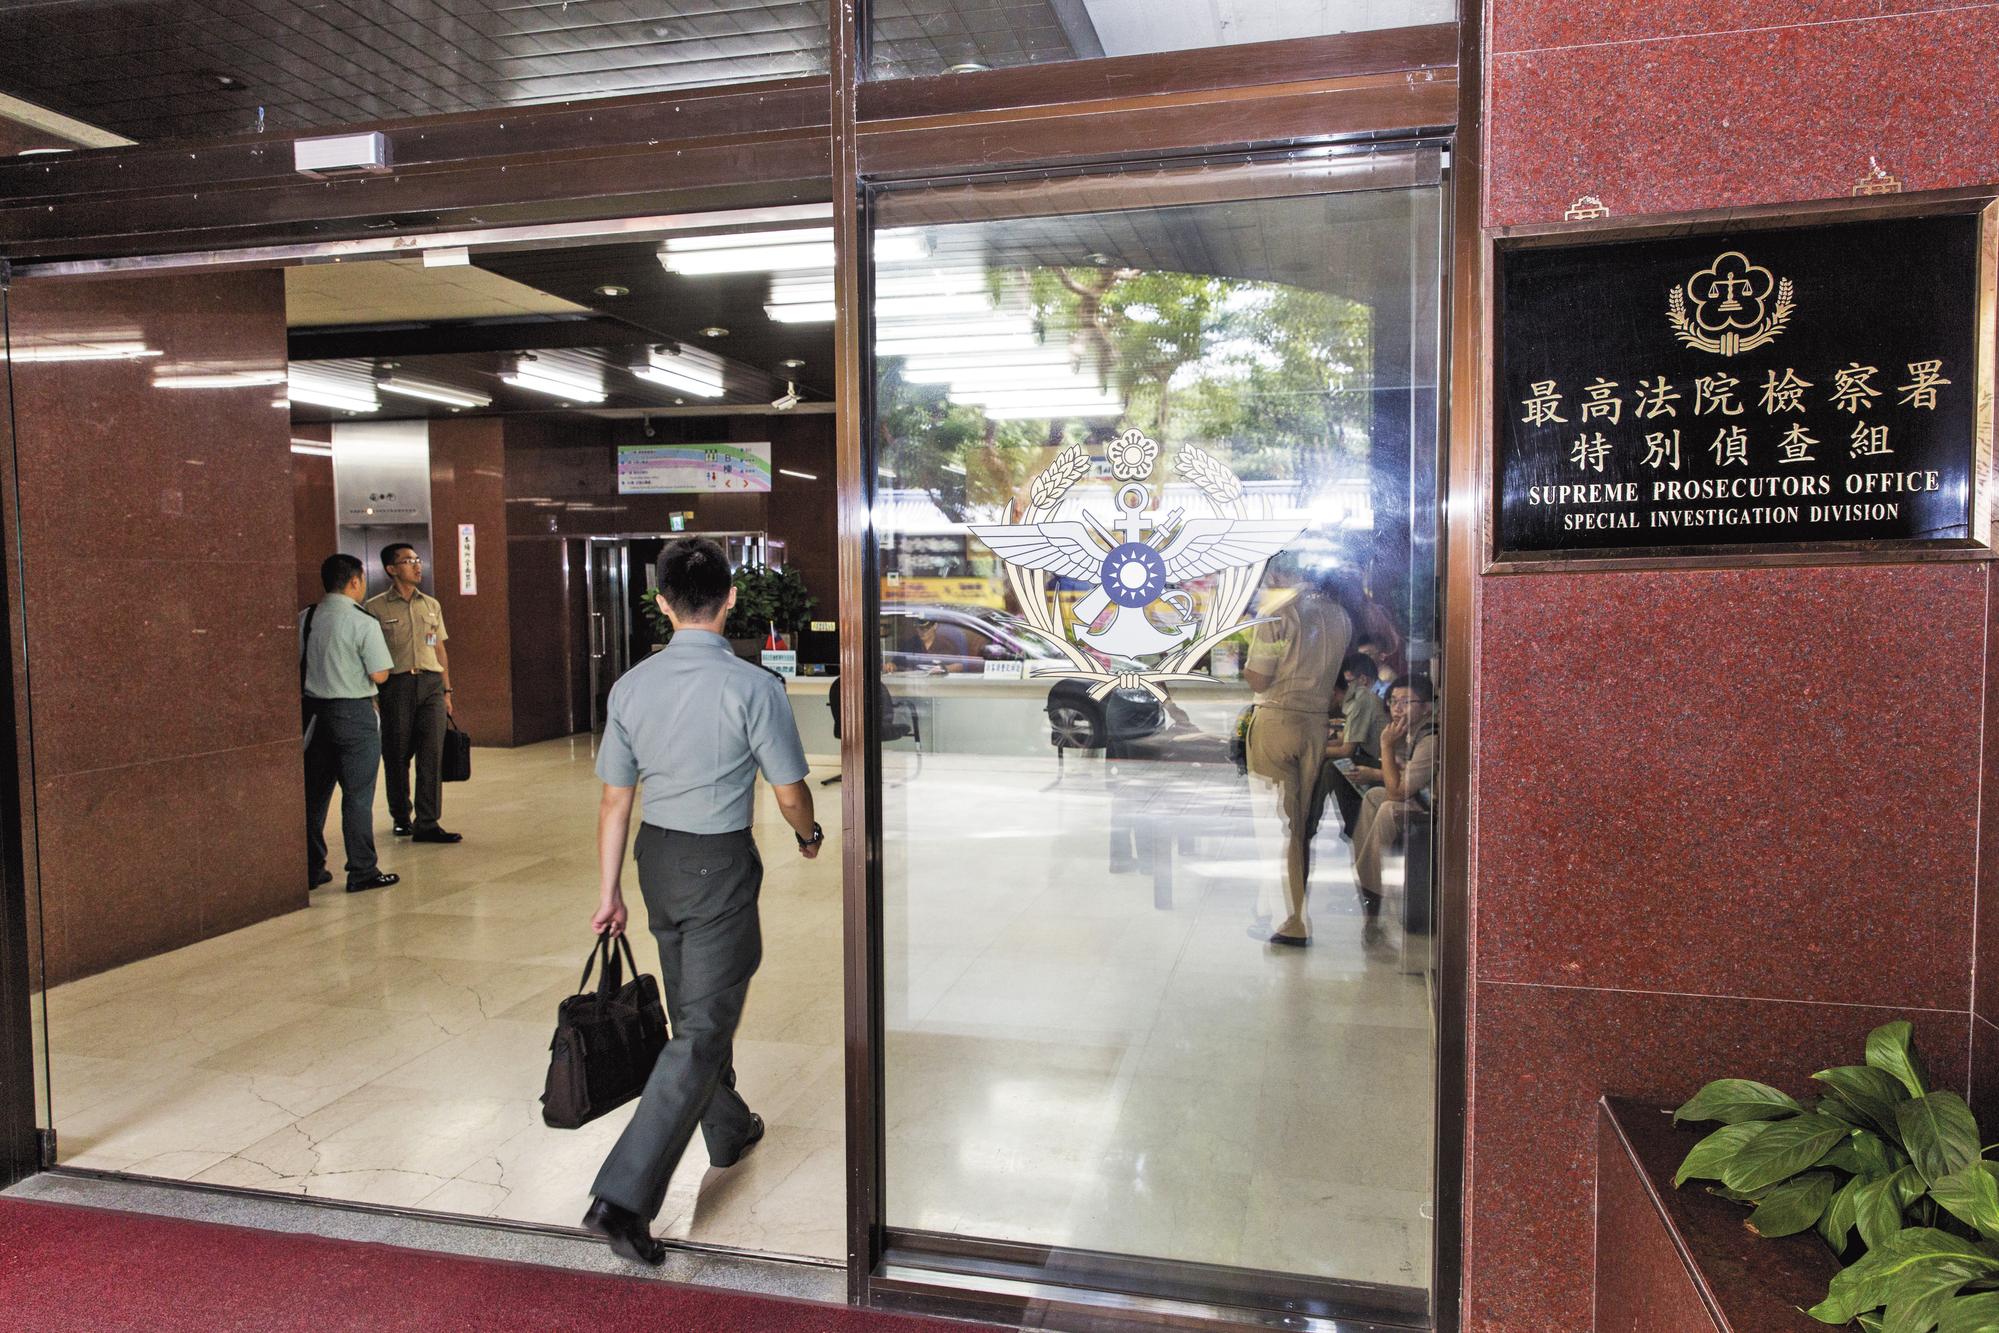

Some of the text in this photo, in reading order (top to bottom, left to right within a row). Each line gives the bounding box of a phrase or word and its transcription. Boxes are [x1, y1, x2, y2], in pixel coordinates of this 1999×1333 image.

[1521, 359, 1952, 428] 最高法院檢察署
[1569, 420, 1894, 473] 特別偵查組
[1529, 470, 1940, 505] SUPREME PROSECUTORS OFFICE
[1564, 502, 1899, 531] SPECIAL INVESTIGATION DIVISION
